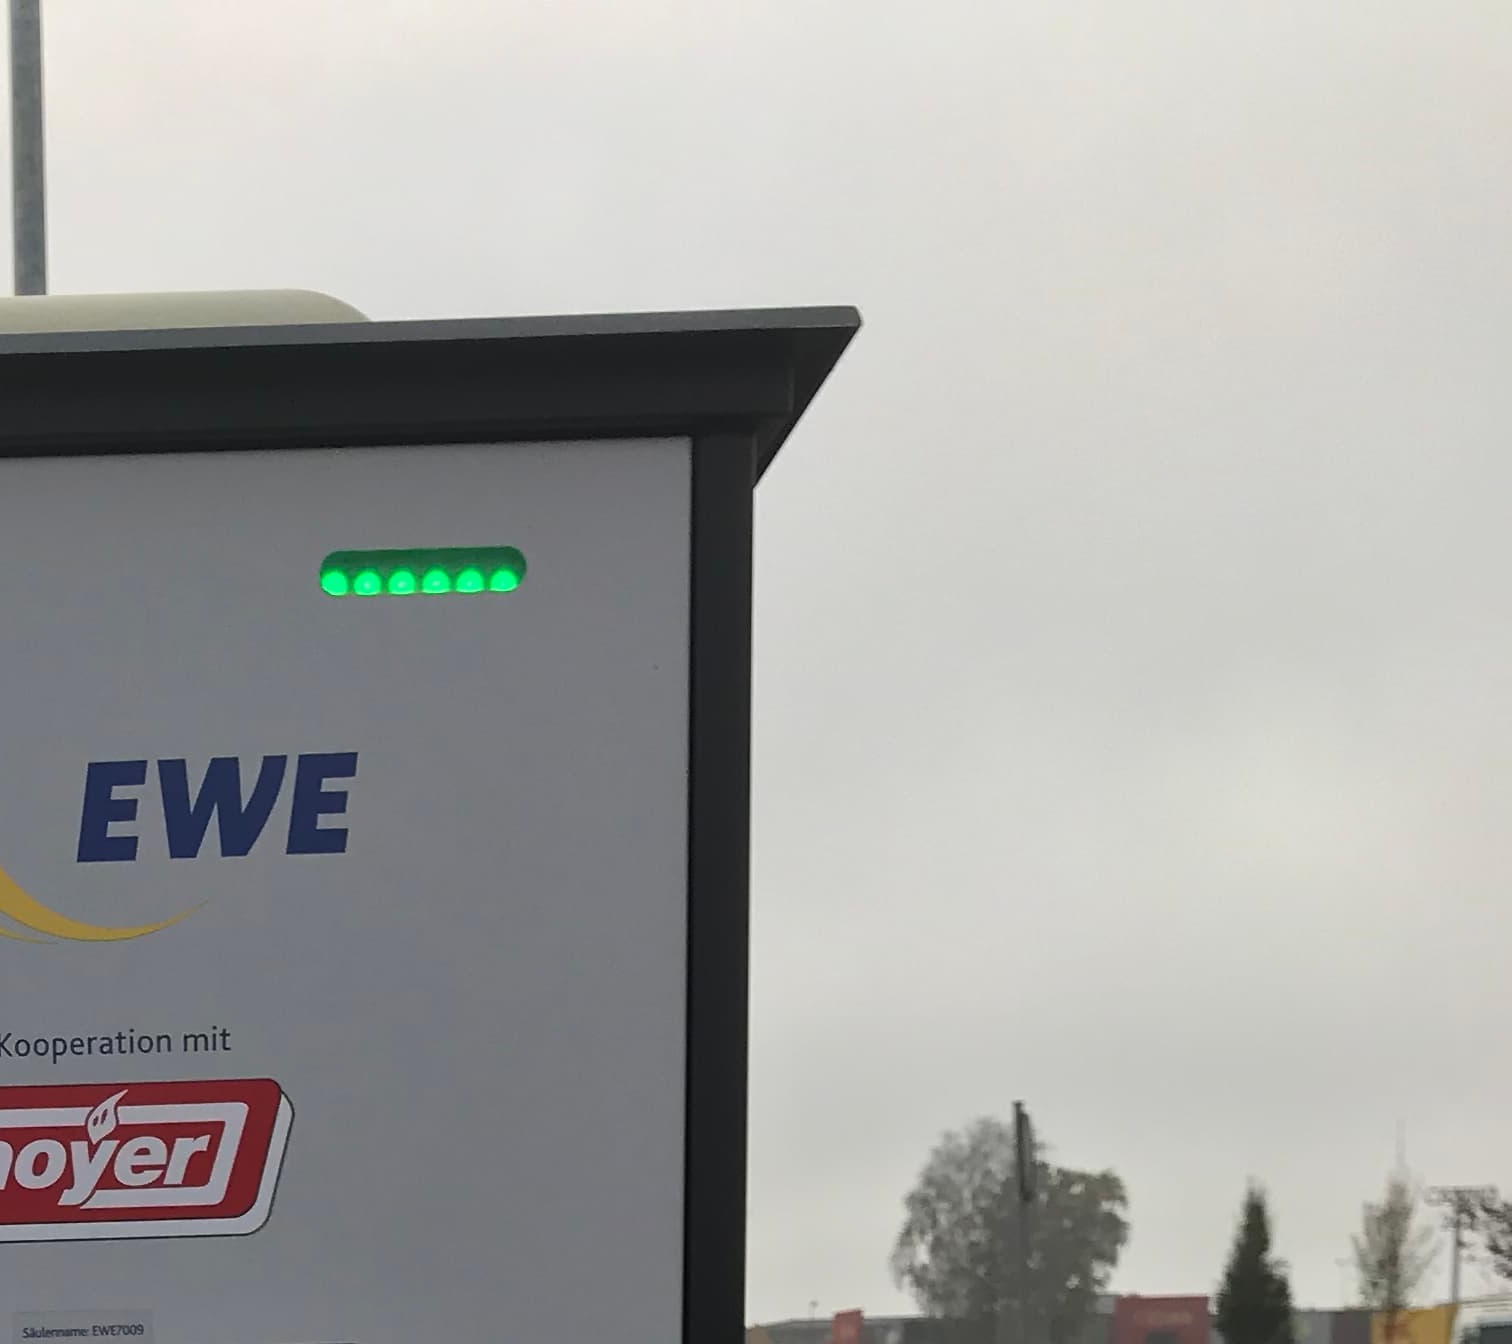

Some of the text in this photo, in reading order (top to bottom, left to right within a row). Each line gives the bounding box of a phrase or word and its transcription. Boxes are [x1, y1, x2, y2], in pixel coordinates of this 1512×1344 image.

[76, 751, 358, 864] EWE
[182, 1026, 232, 1053] mit
[92, 1323, 145, 1337] EWE7009
